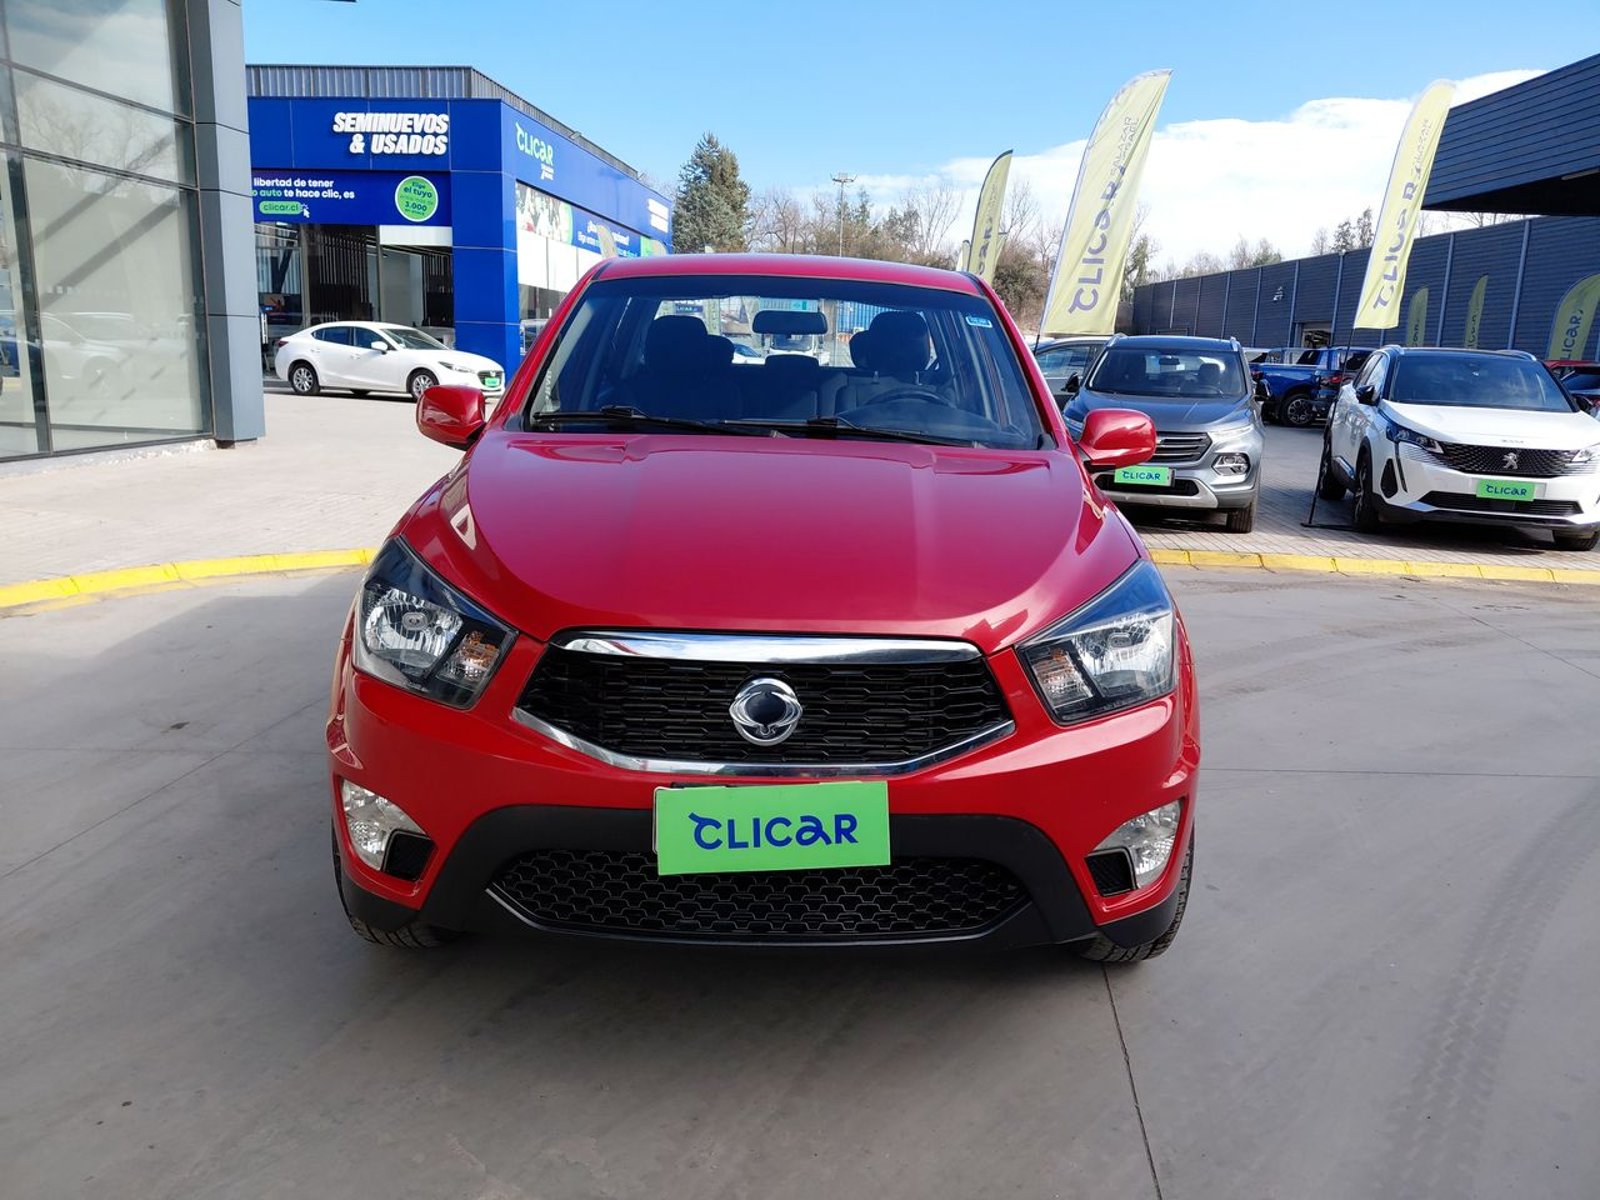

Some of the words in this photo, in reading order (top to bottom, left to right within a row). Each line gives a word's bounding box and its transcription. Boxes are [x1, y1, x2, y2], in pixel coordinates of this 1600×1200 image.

[333, 112, 449, 133] SEMINUEVOS
[349, 134, 365, 154] &
[370, 134, 448, 155] USADOS
[253, 177, 292, 187] libertad
[293, 178, 307, 187] de
[307, 179, 334, 188] tener
[283, 189, 294, 197] te
[295, 189, 320, 198] hace
[343, 191, 355, 199] es
